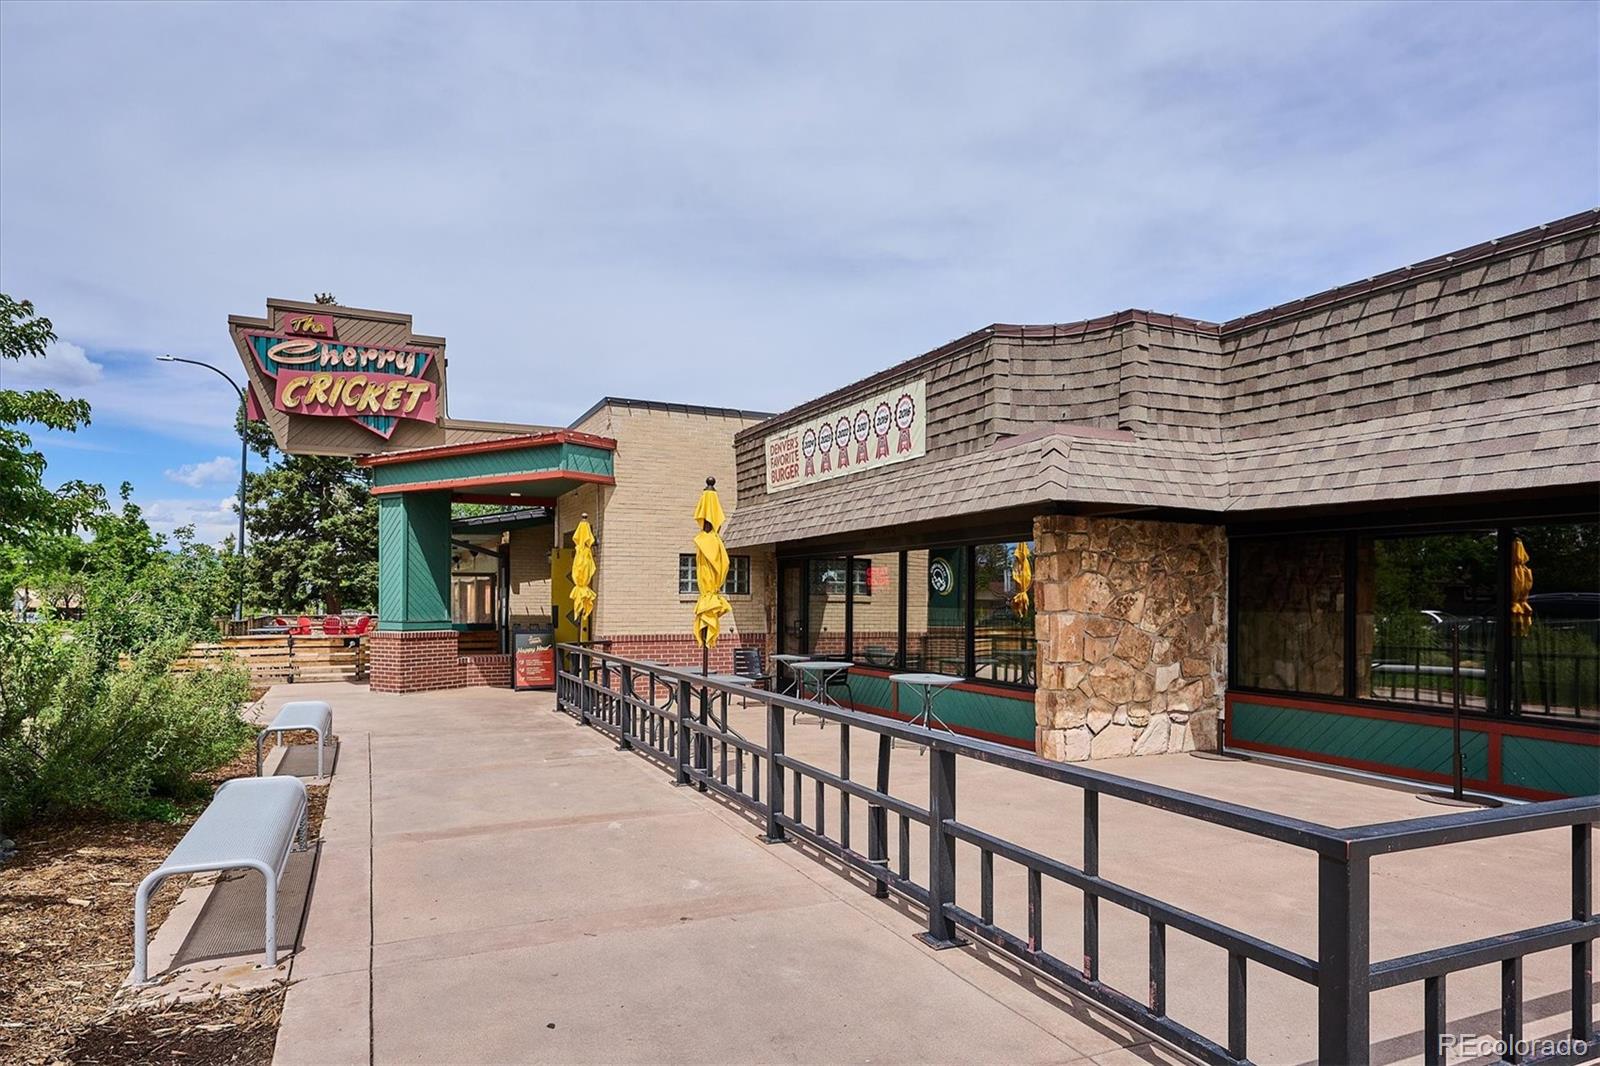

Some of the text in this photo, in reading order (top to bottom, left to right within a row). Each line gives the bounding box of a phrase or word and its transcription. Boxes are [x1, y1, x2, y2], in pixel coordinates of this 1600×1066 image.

[290, 315, 328, 334] The
[267, 339, 416, 376] Cherry
[281, 372, 430, 413] CRICKET
[770, 437, 799, 456] DENVER'S
[770, 450, 800, 469] FAVORITE
[771, 463, 800, 484] BURGER
